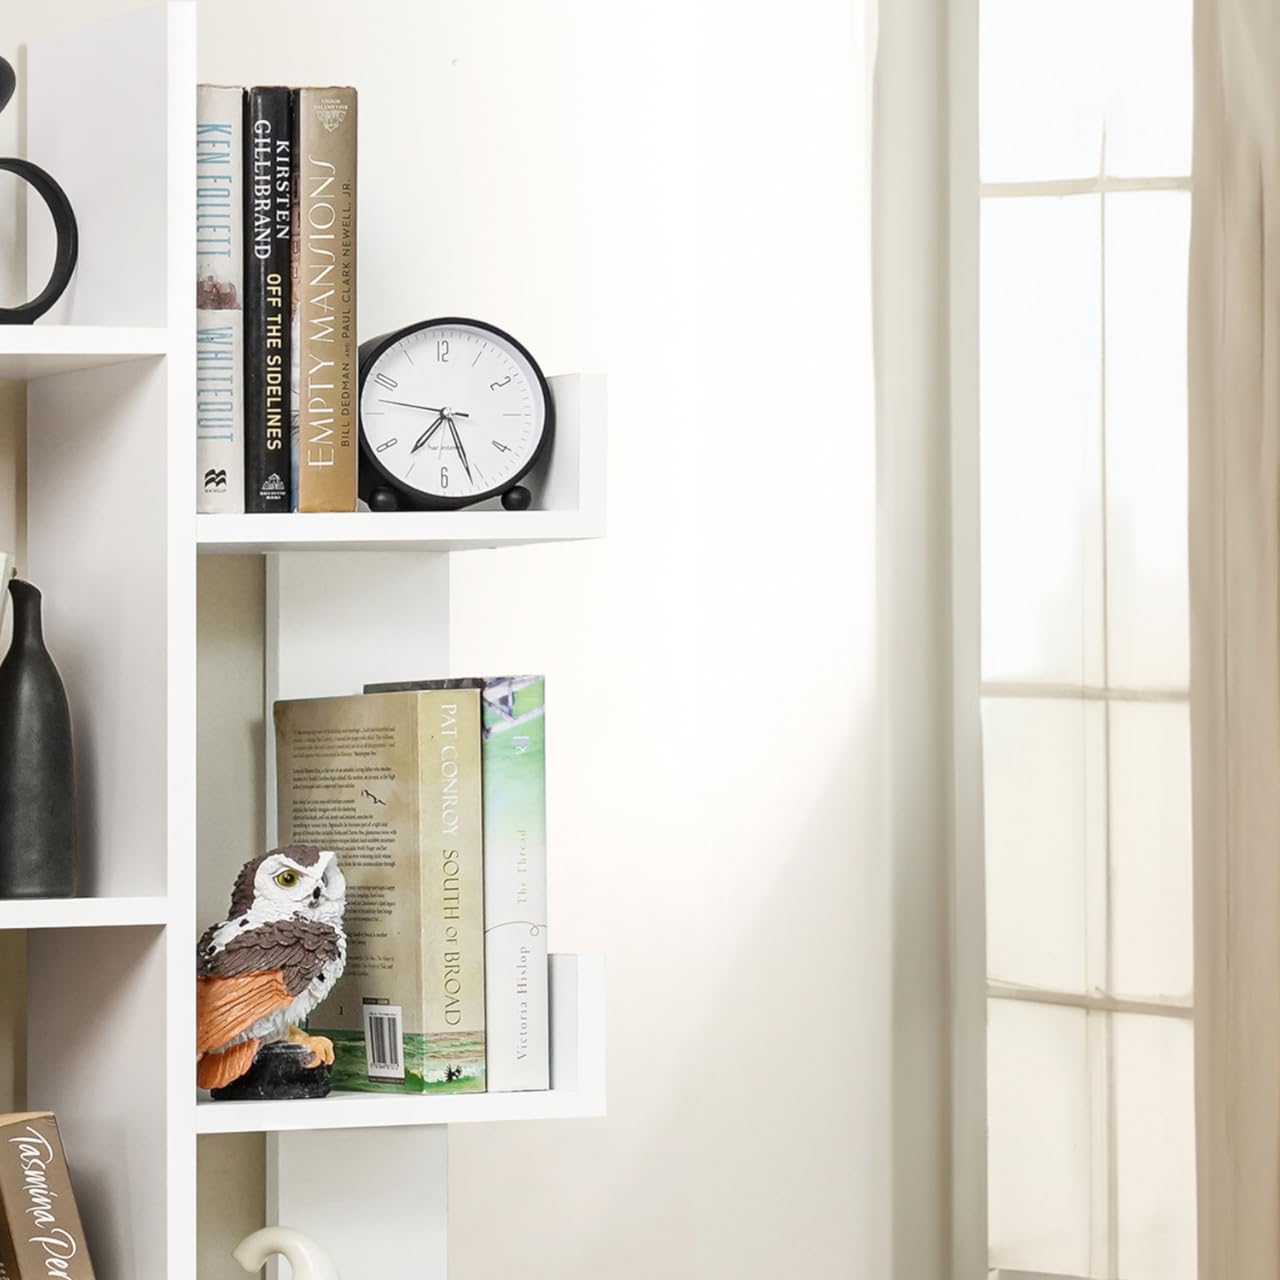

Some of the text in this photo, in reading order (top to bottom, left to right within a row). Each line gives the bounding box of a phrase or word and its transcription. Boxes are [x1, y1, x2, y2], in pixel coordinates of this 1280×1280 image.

[197, 124, 231, 257] KEN FOLLETT
[254, 119, 272, 260] GILLIBRAND
[276, 140, 290, 239] KIRSTEN
[341, 262, 352, 303] CLARK
[308, 155, 336, 470] EMPTY MANSIONS
[341, 308, 351, 339] PAUL
[266, 274, 282, 450] OFF THE SIDELINES
[437, 340, 449, 362] 12
[197, 326, 233, 442] WHITEOUT
[341, 362, 350, 416] DEDMAN
[374, 373, 398, 391] 10
[490, 376, 511, 391] 2
[341, 420, 350, 447] BILL
[376, 438, 397, 452] 8
[492, 440, 512, 452] 4
[440, 466, 449, 489] 6
[440, 703, 460, 834] PAT CONROY
[442, 849, 460, 919] SOUTH
[517, 881, 527, 904] The
[443, 951, 461, 1026] BROAD
[516, 946, 530, 1060] Victoria Hislop
